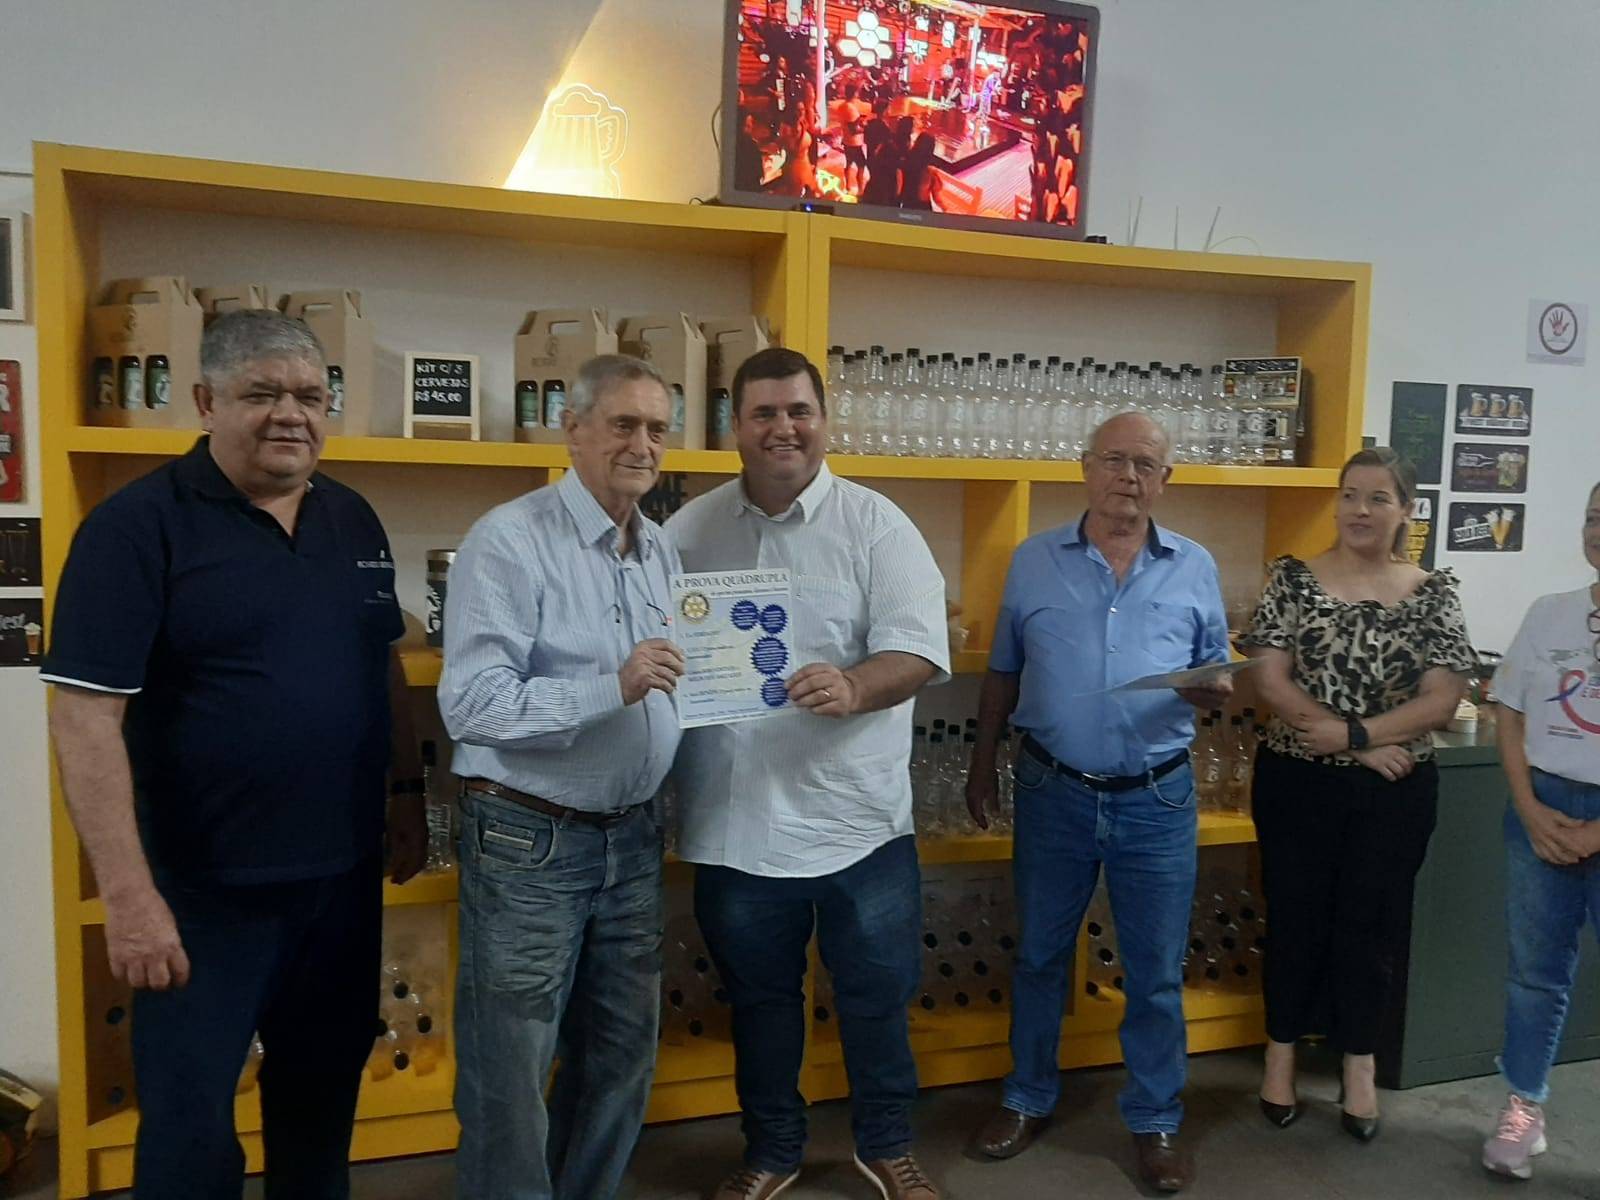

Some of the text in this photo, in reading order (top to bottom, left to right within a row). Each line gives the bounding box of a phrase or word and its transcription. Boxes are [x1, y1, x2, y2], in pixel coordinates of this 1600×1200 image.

[416, 362, 437, 373] KIT
[674, 579, 682, 589] A
[683, 577, 720, 589] PROVA
